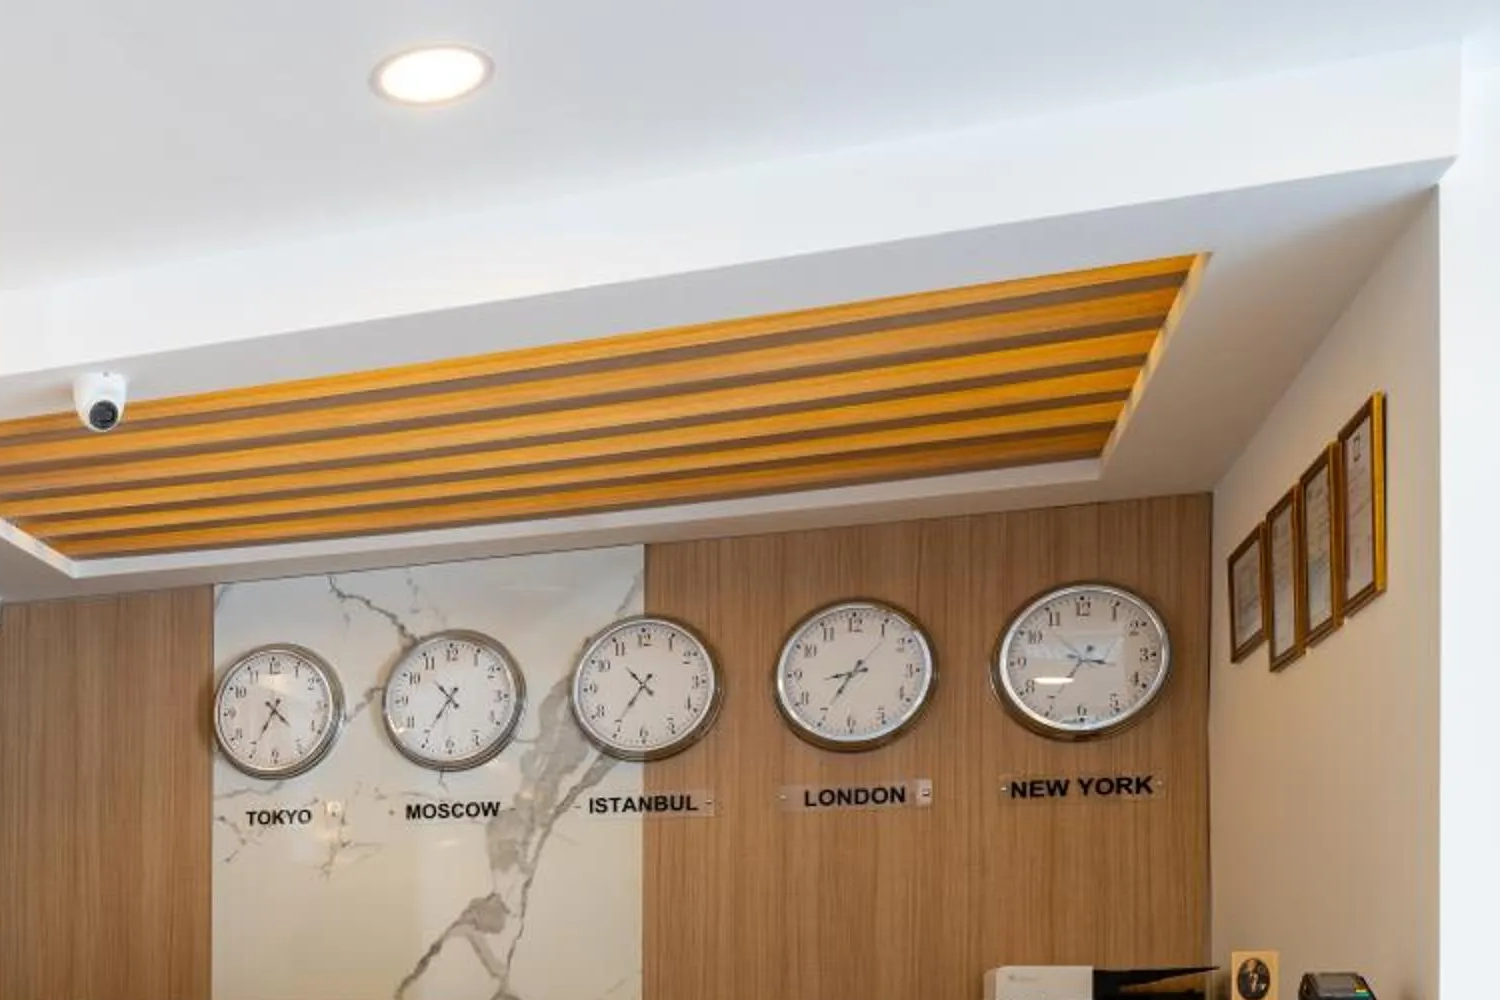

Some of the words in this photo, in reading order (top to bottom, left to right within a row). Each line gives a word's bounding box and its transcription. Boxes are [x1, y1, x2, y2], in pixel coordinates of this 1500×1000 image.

[1075, 599, 1091, 617] 12
[848, 618, 863, 633] 12
[1048, 612, 1060, 627] 11
[638, 633, 652, 648] 12
[823, 627, 834, 641] 11
[1028, 629, 1043, 644] 10
[446, 647, 459, 662] 12
[615, 642, 625, 656] 11
[804, 643, 816, 658] 10
[425, 656, 435, 671] 11
[599, 659, 611, 672] 10
[409, 671, 421, 685] 10
[1010, 779, 1070, 799] NEW
[1077, 775, 1154, 796] YORK
[804, 786, 906, 807] LONDON
[405, 801, 501, 821] MOSCOW
[589, 795, 698, 814] ISTANBUL
[246, 808, 313, 826] TOKYO
